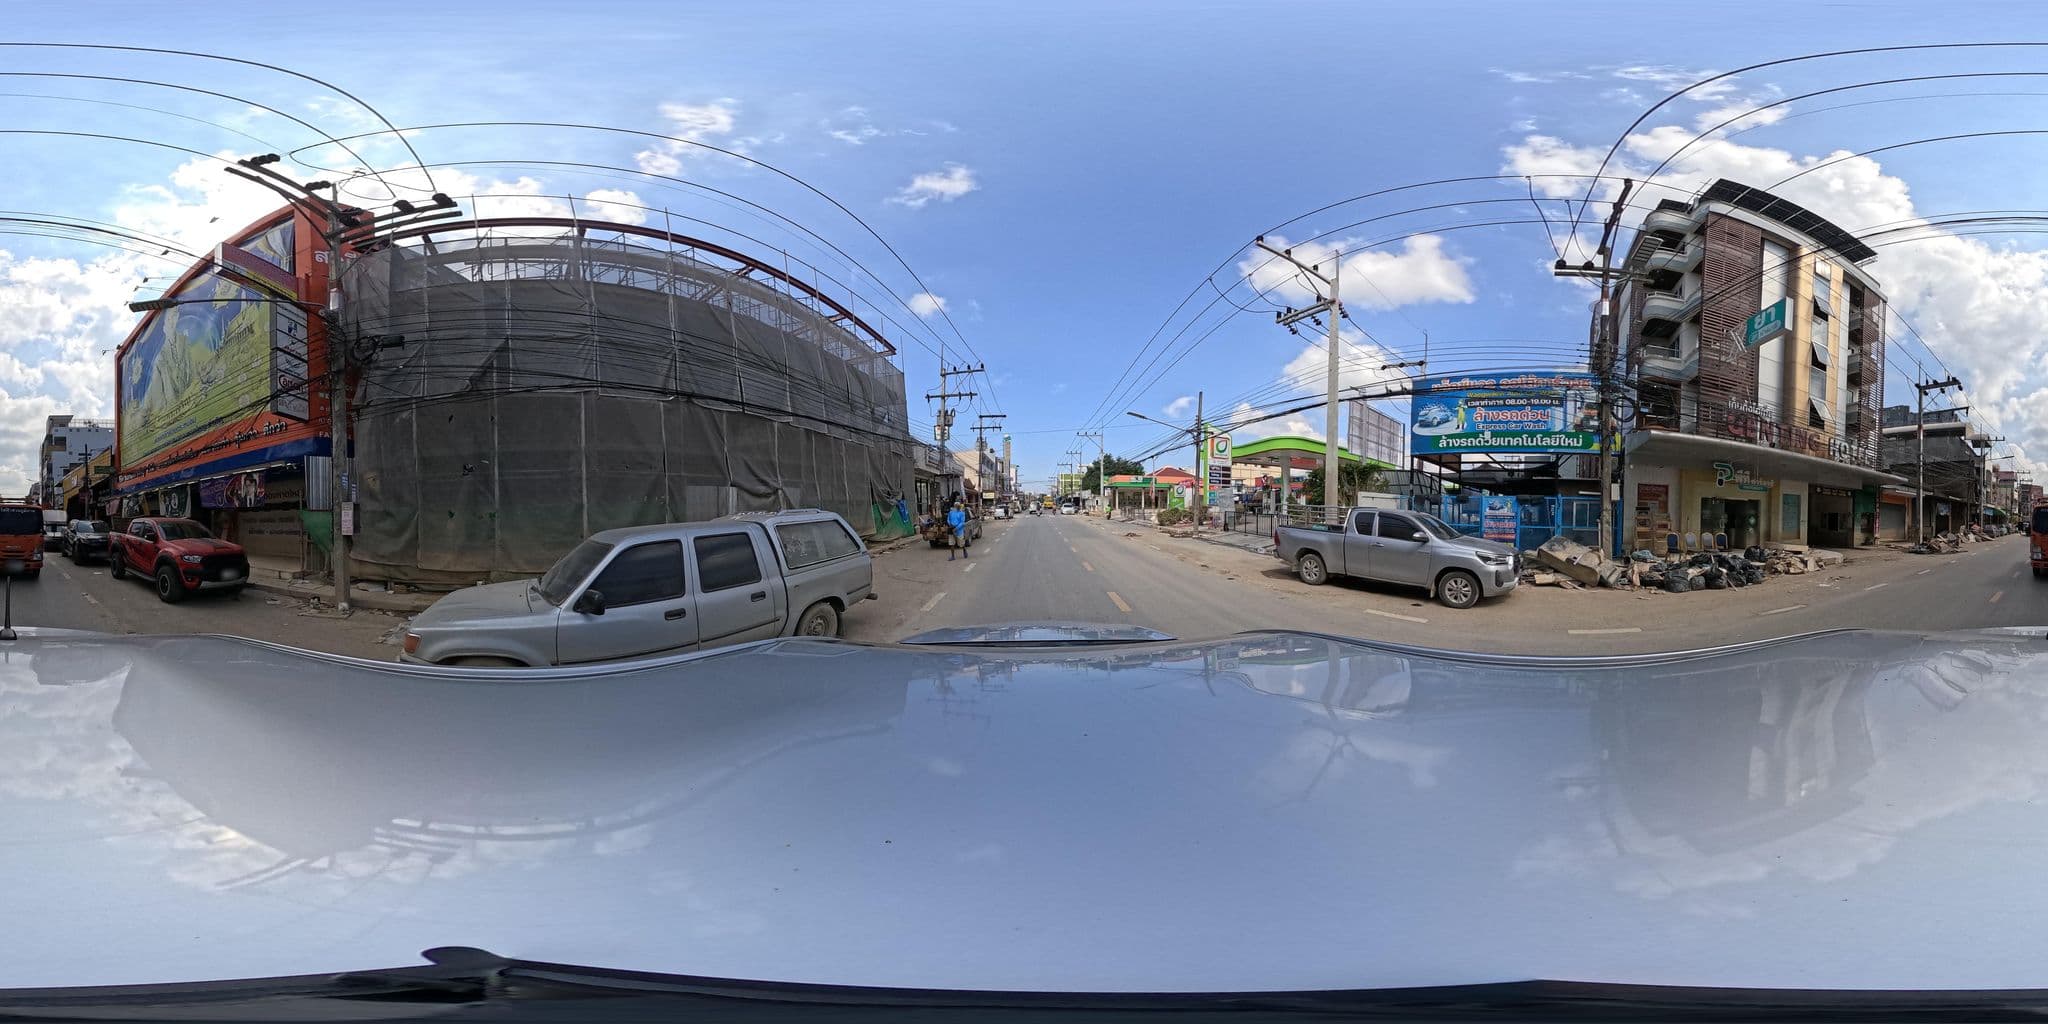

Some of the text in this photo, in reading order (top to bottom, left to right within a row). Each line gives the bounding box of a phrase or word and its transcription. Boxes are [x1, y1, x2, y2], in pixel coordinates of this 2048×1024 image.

[1754, 307, 1776, 329] ยา
[1467, 399, 1503, 407] เวลาทำการ
[1473, 406, 1551, 421] ล้างรถด่วน
[1438, 433, 1583, 448] ล้างรถด้วยเทคโนโลยีใหม่
